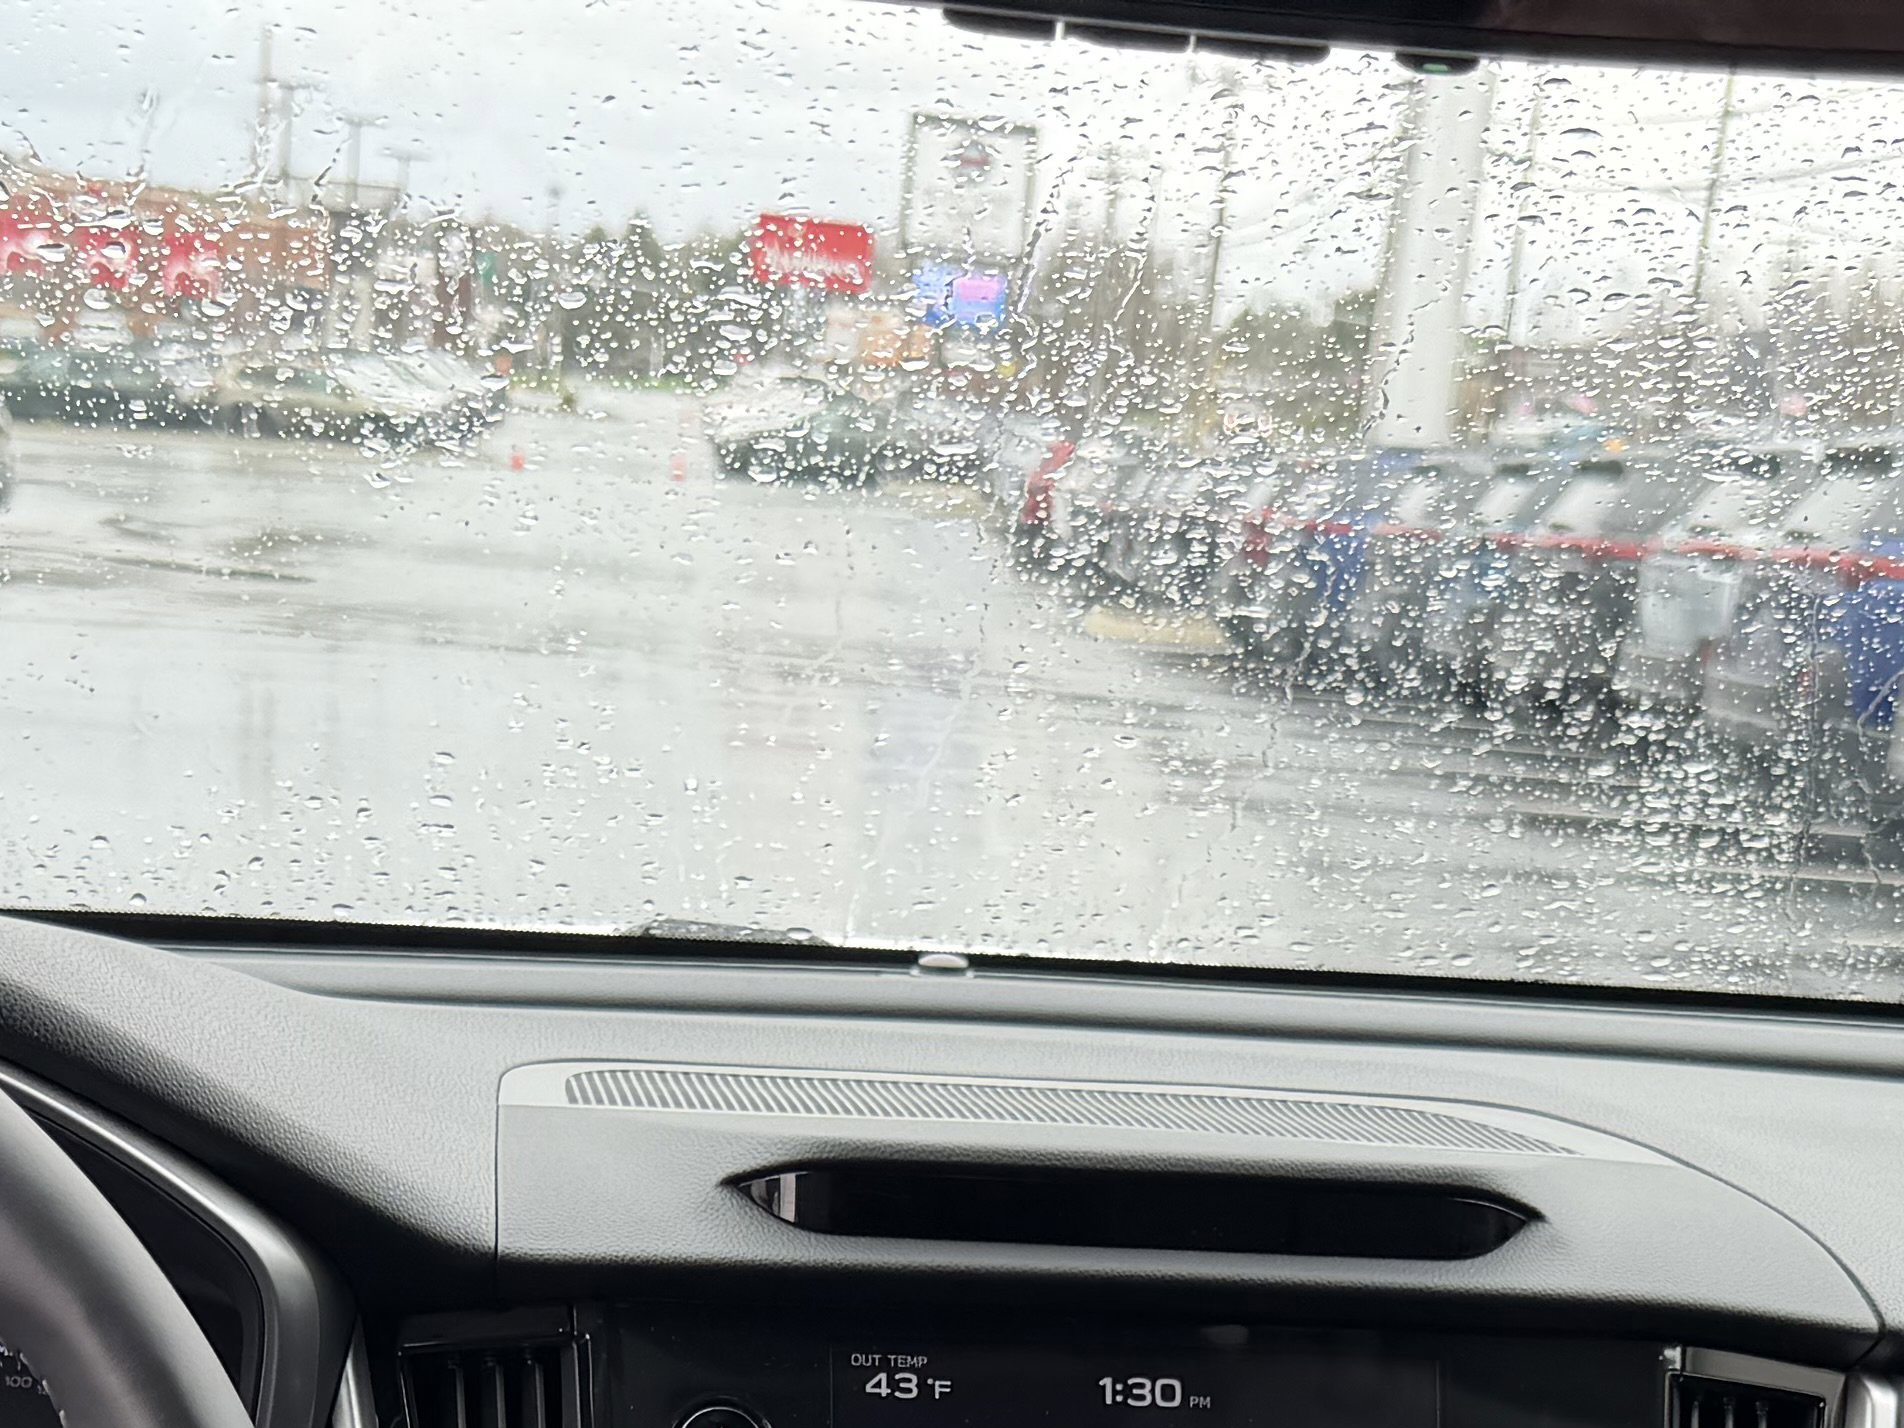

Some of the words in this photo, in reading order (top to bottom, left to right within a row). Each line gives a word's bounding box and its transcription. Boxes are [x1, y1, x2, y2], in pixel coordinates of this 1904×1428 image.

[851, 1353, 881, 1367] OUT
[890, 1355, 928, 1368] TEMP
[5, 1376, 33, 1389] 100
[865, 1373, 919, 1398] 43
[1098, 1377, 1183, 1408] 1:30
[1190, 1397, 1211, 1408] PM
